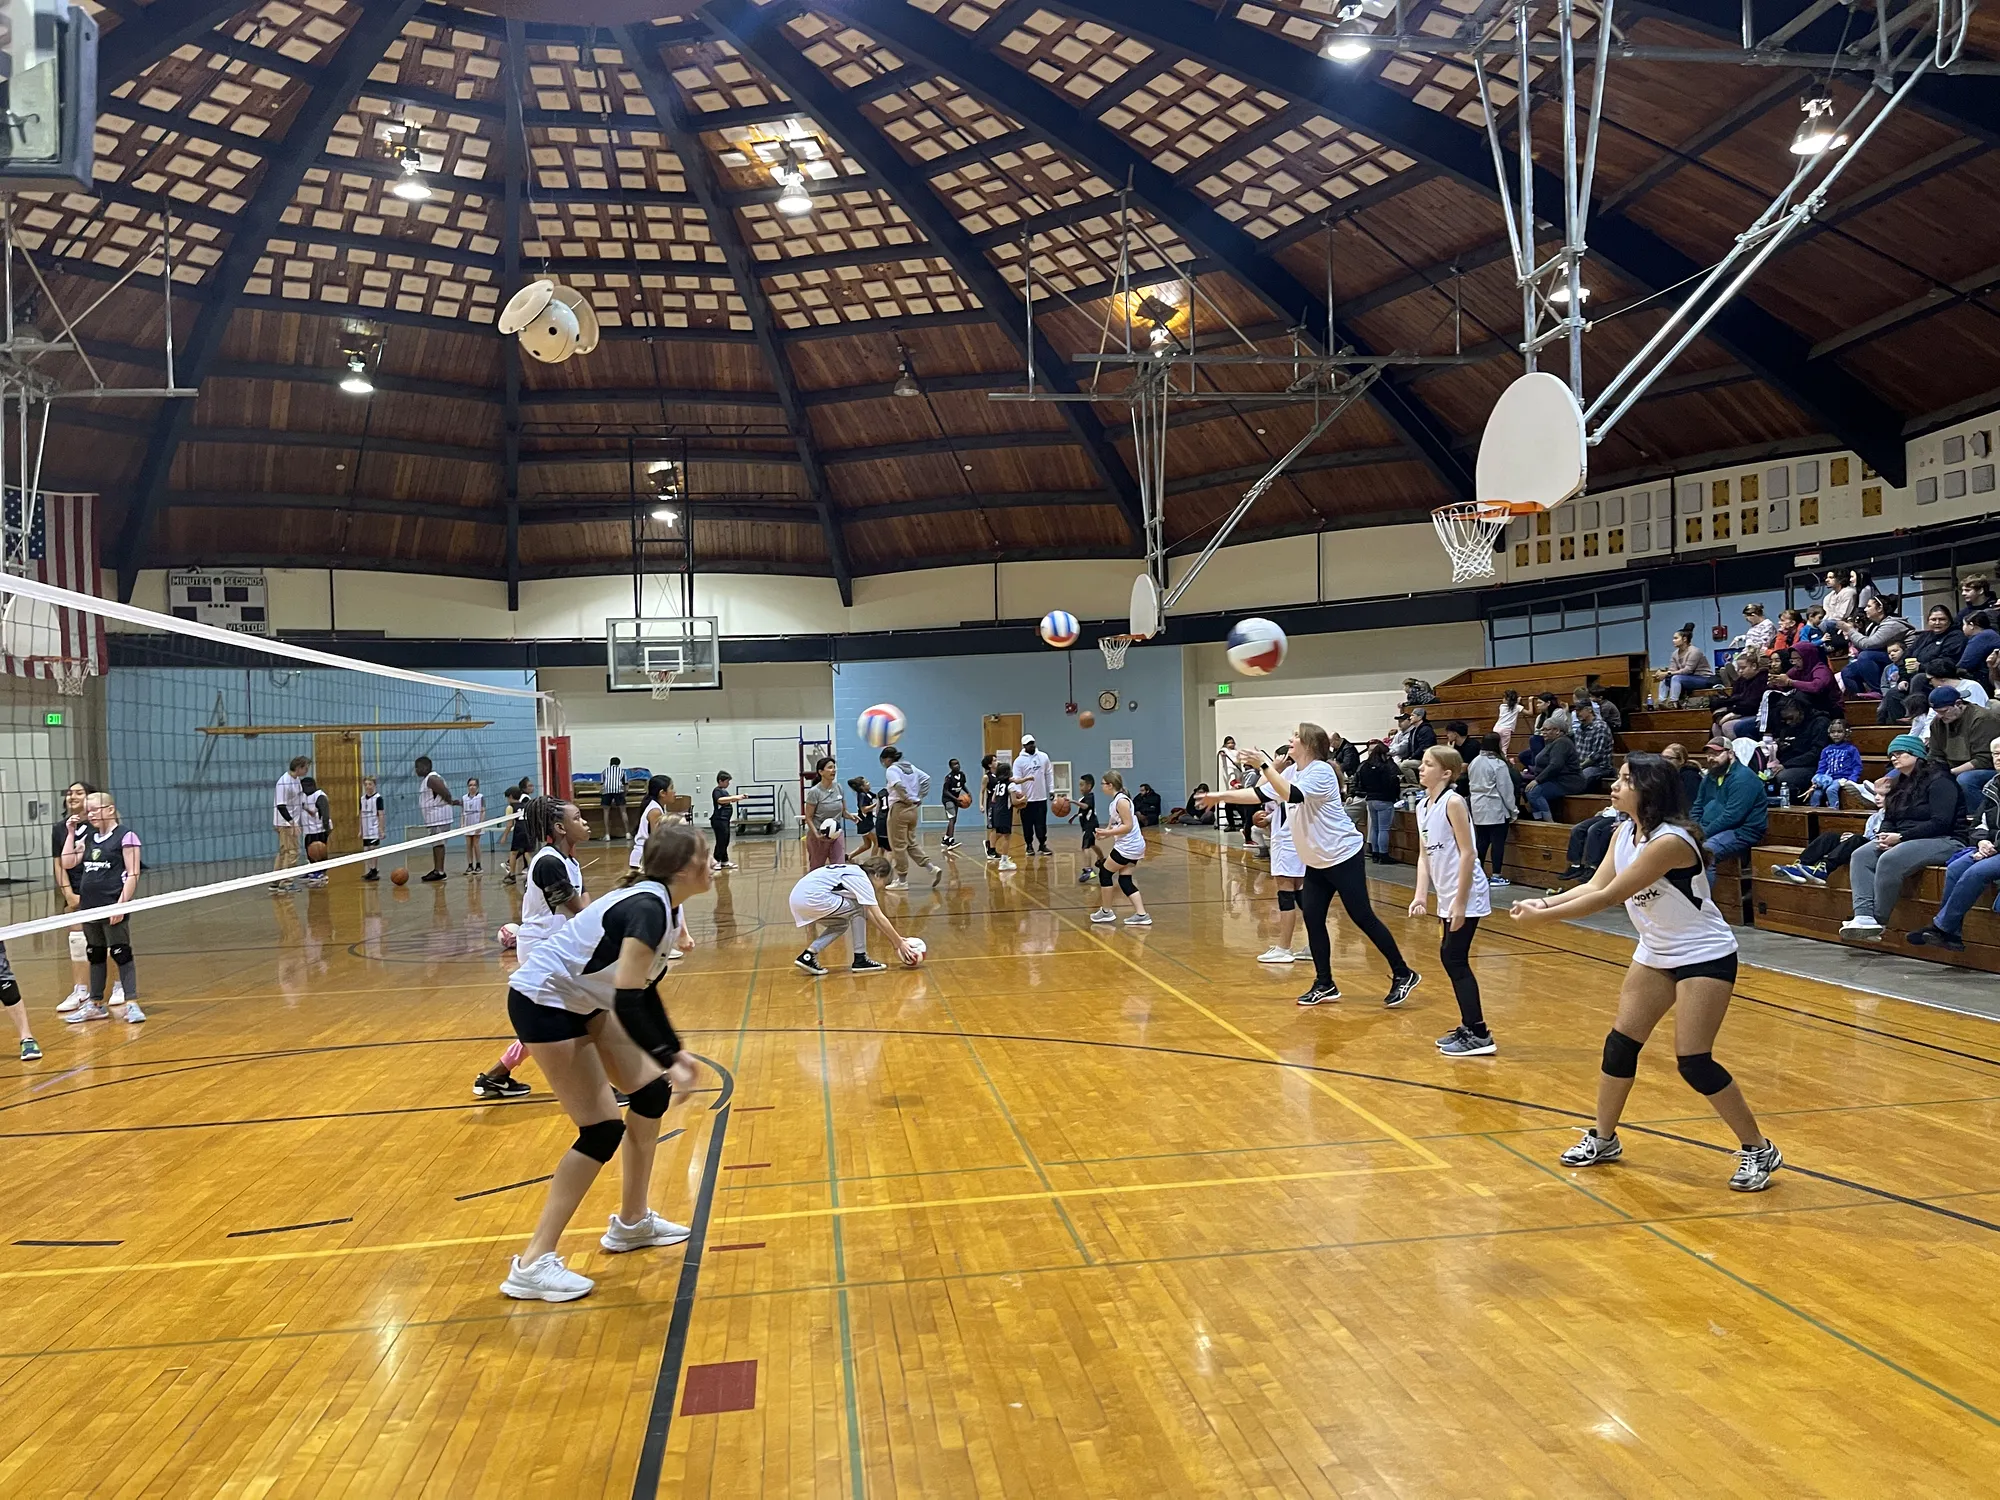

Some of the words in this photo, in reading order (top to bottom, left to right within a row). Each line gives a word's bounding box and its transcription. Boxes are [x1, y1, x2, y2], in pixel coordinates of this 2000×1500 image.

[172, 577, 211, 586] MINUTES
[225, 577, 263, 586] SECONDS
[227, 623, 265, 632] VISITOR
